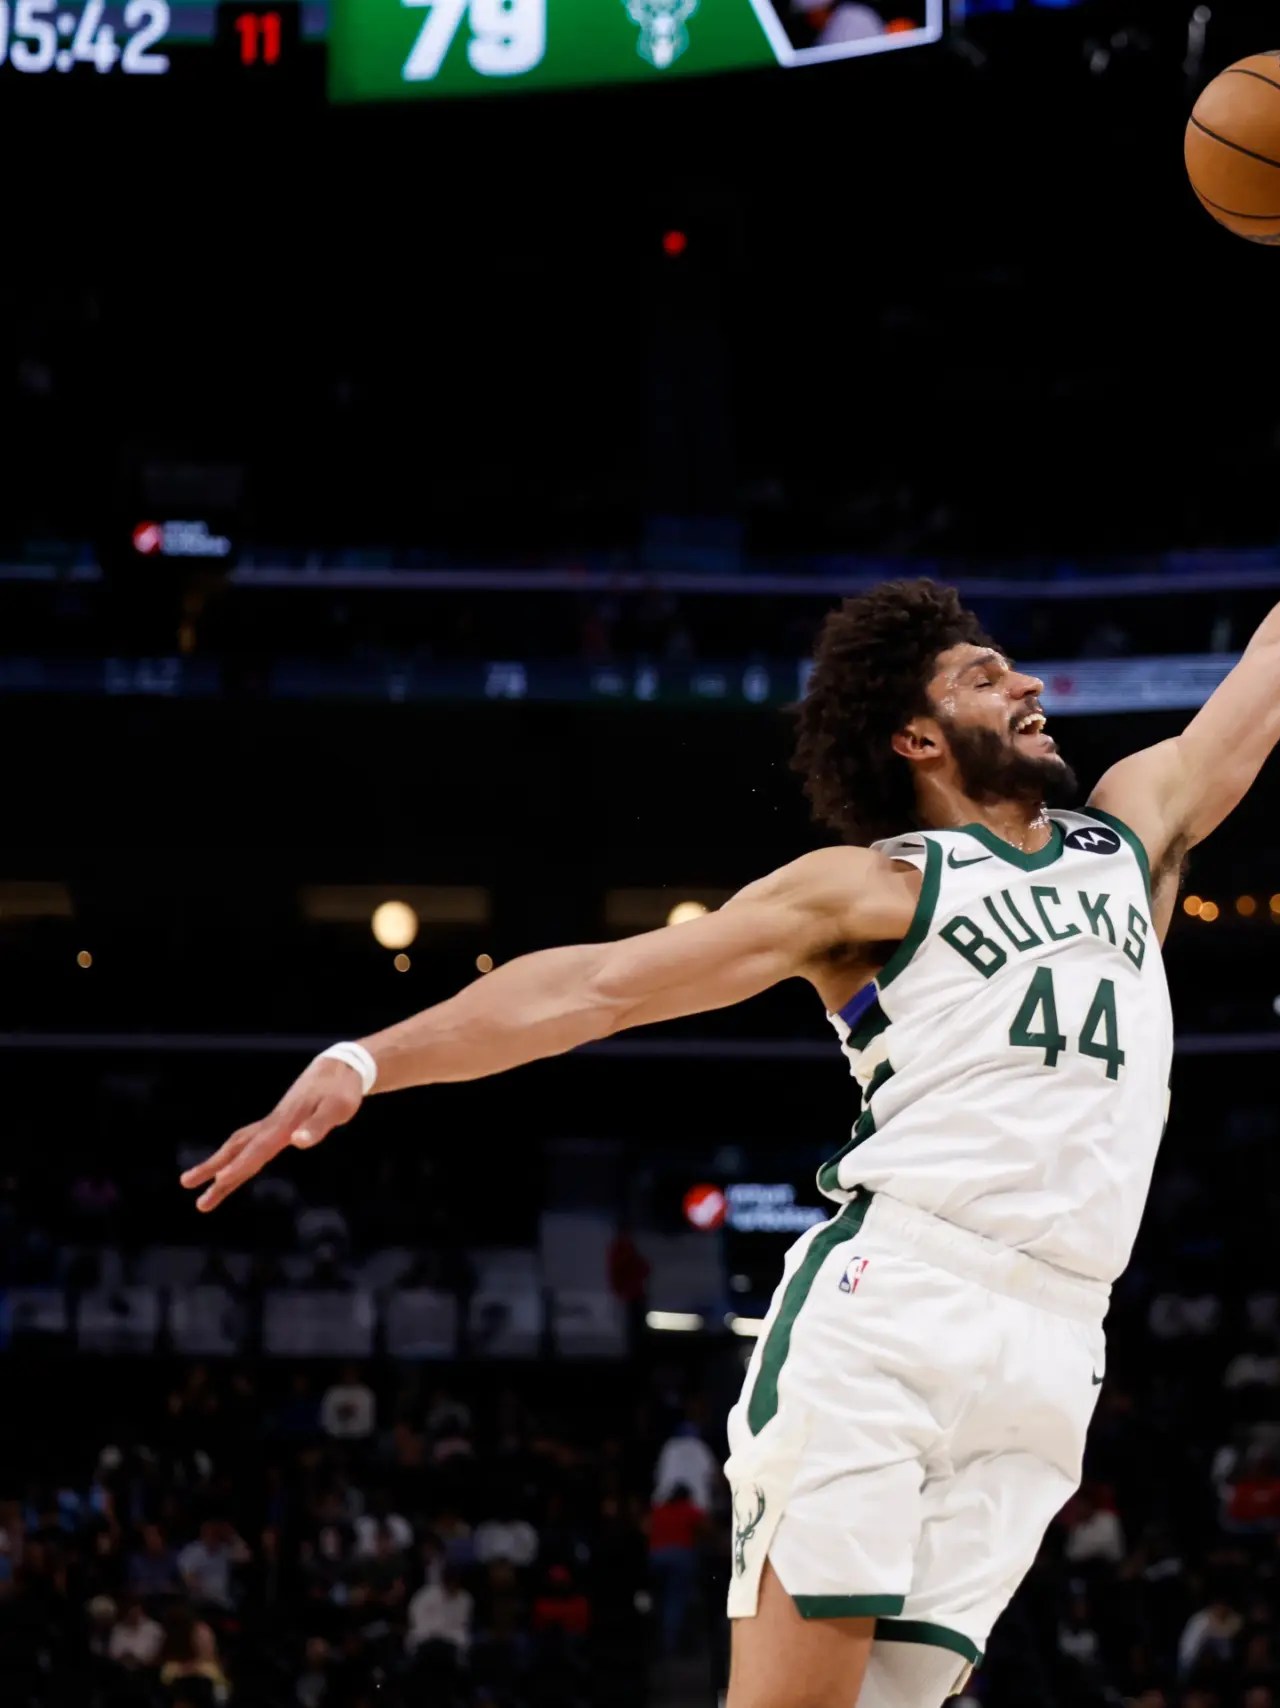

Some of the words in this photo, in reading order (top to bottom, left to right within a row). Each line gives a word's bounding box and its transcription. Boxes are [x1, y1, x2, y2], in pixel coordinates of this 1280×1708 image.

[235, 11, 281, 65] 11
[401, 0, 547, 82] 79
[939, 885, 1148, 980] BUCKS
[1008, 966, 1125, 1081] 44
